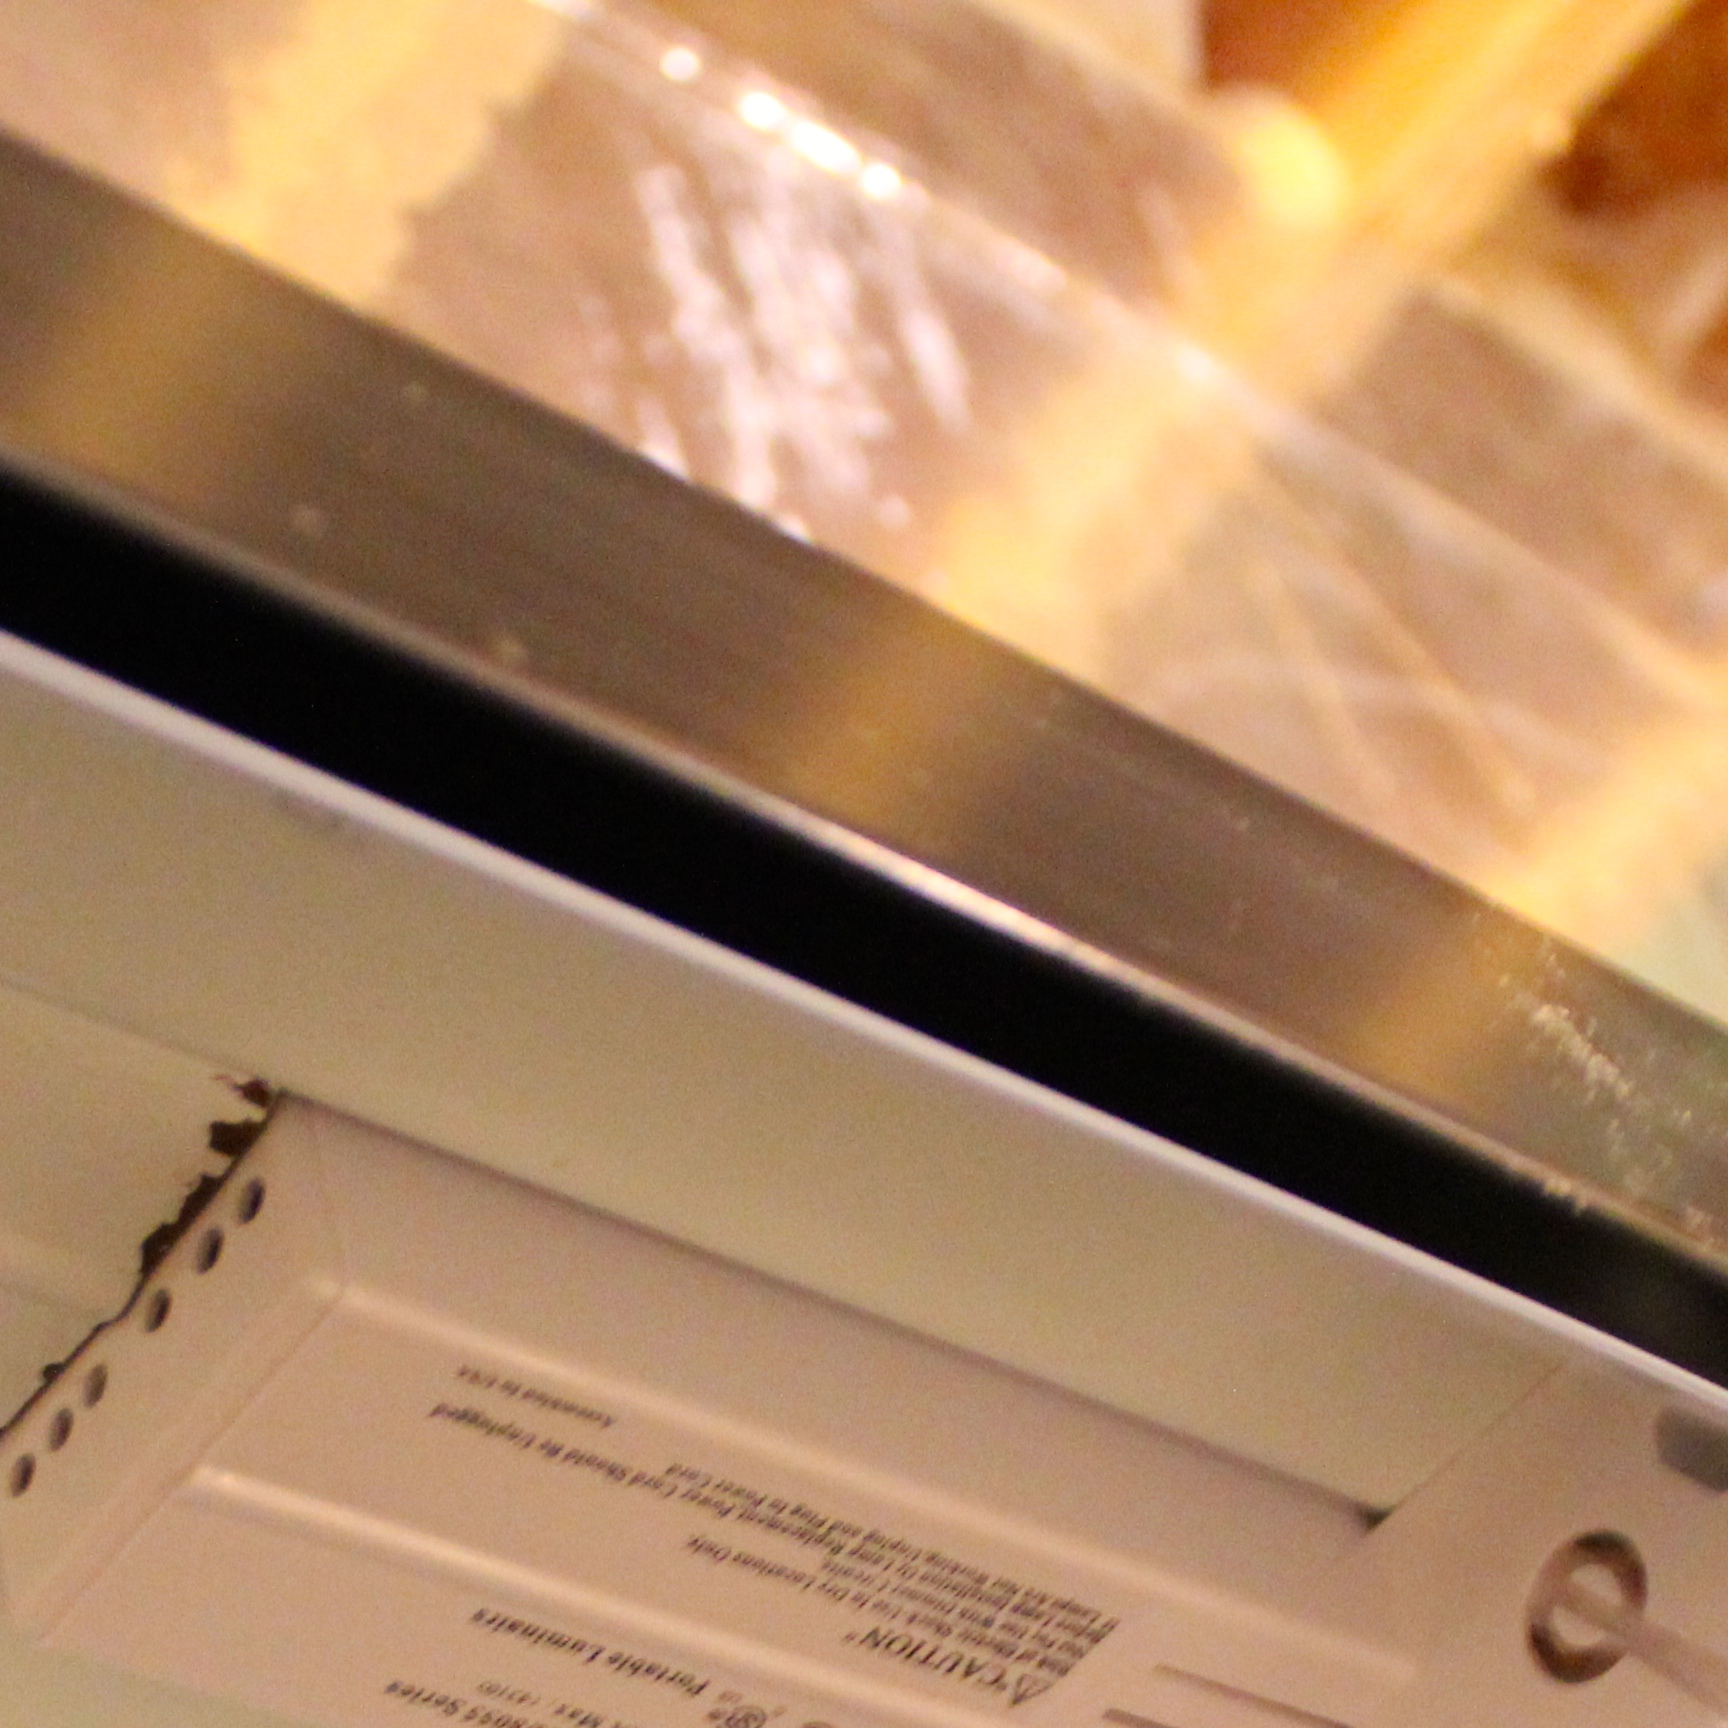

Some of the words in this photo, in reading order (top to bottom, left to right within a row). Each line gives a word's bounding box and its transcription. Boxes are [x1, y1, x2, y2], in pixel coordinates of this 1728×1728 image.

[427, 1402, 536, 1449] Unplugged
[520, 1388, 617, 1429] Assembled
[561, 1448, 627, 1481] Should
[664, 1462, 712, 1487] Cord
[679, 1488, 735, 1518] Power
[713, 1479, 767, 1507] Power
[731, 1552, 815, 1590] Locations
[606, 1652, 710, 1696] Portable
[383, 1680, 465, 1716] Series
